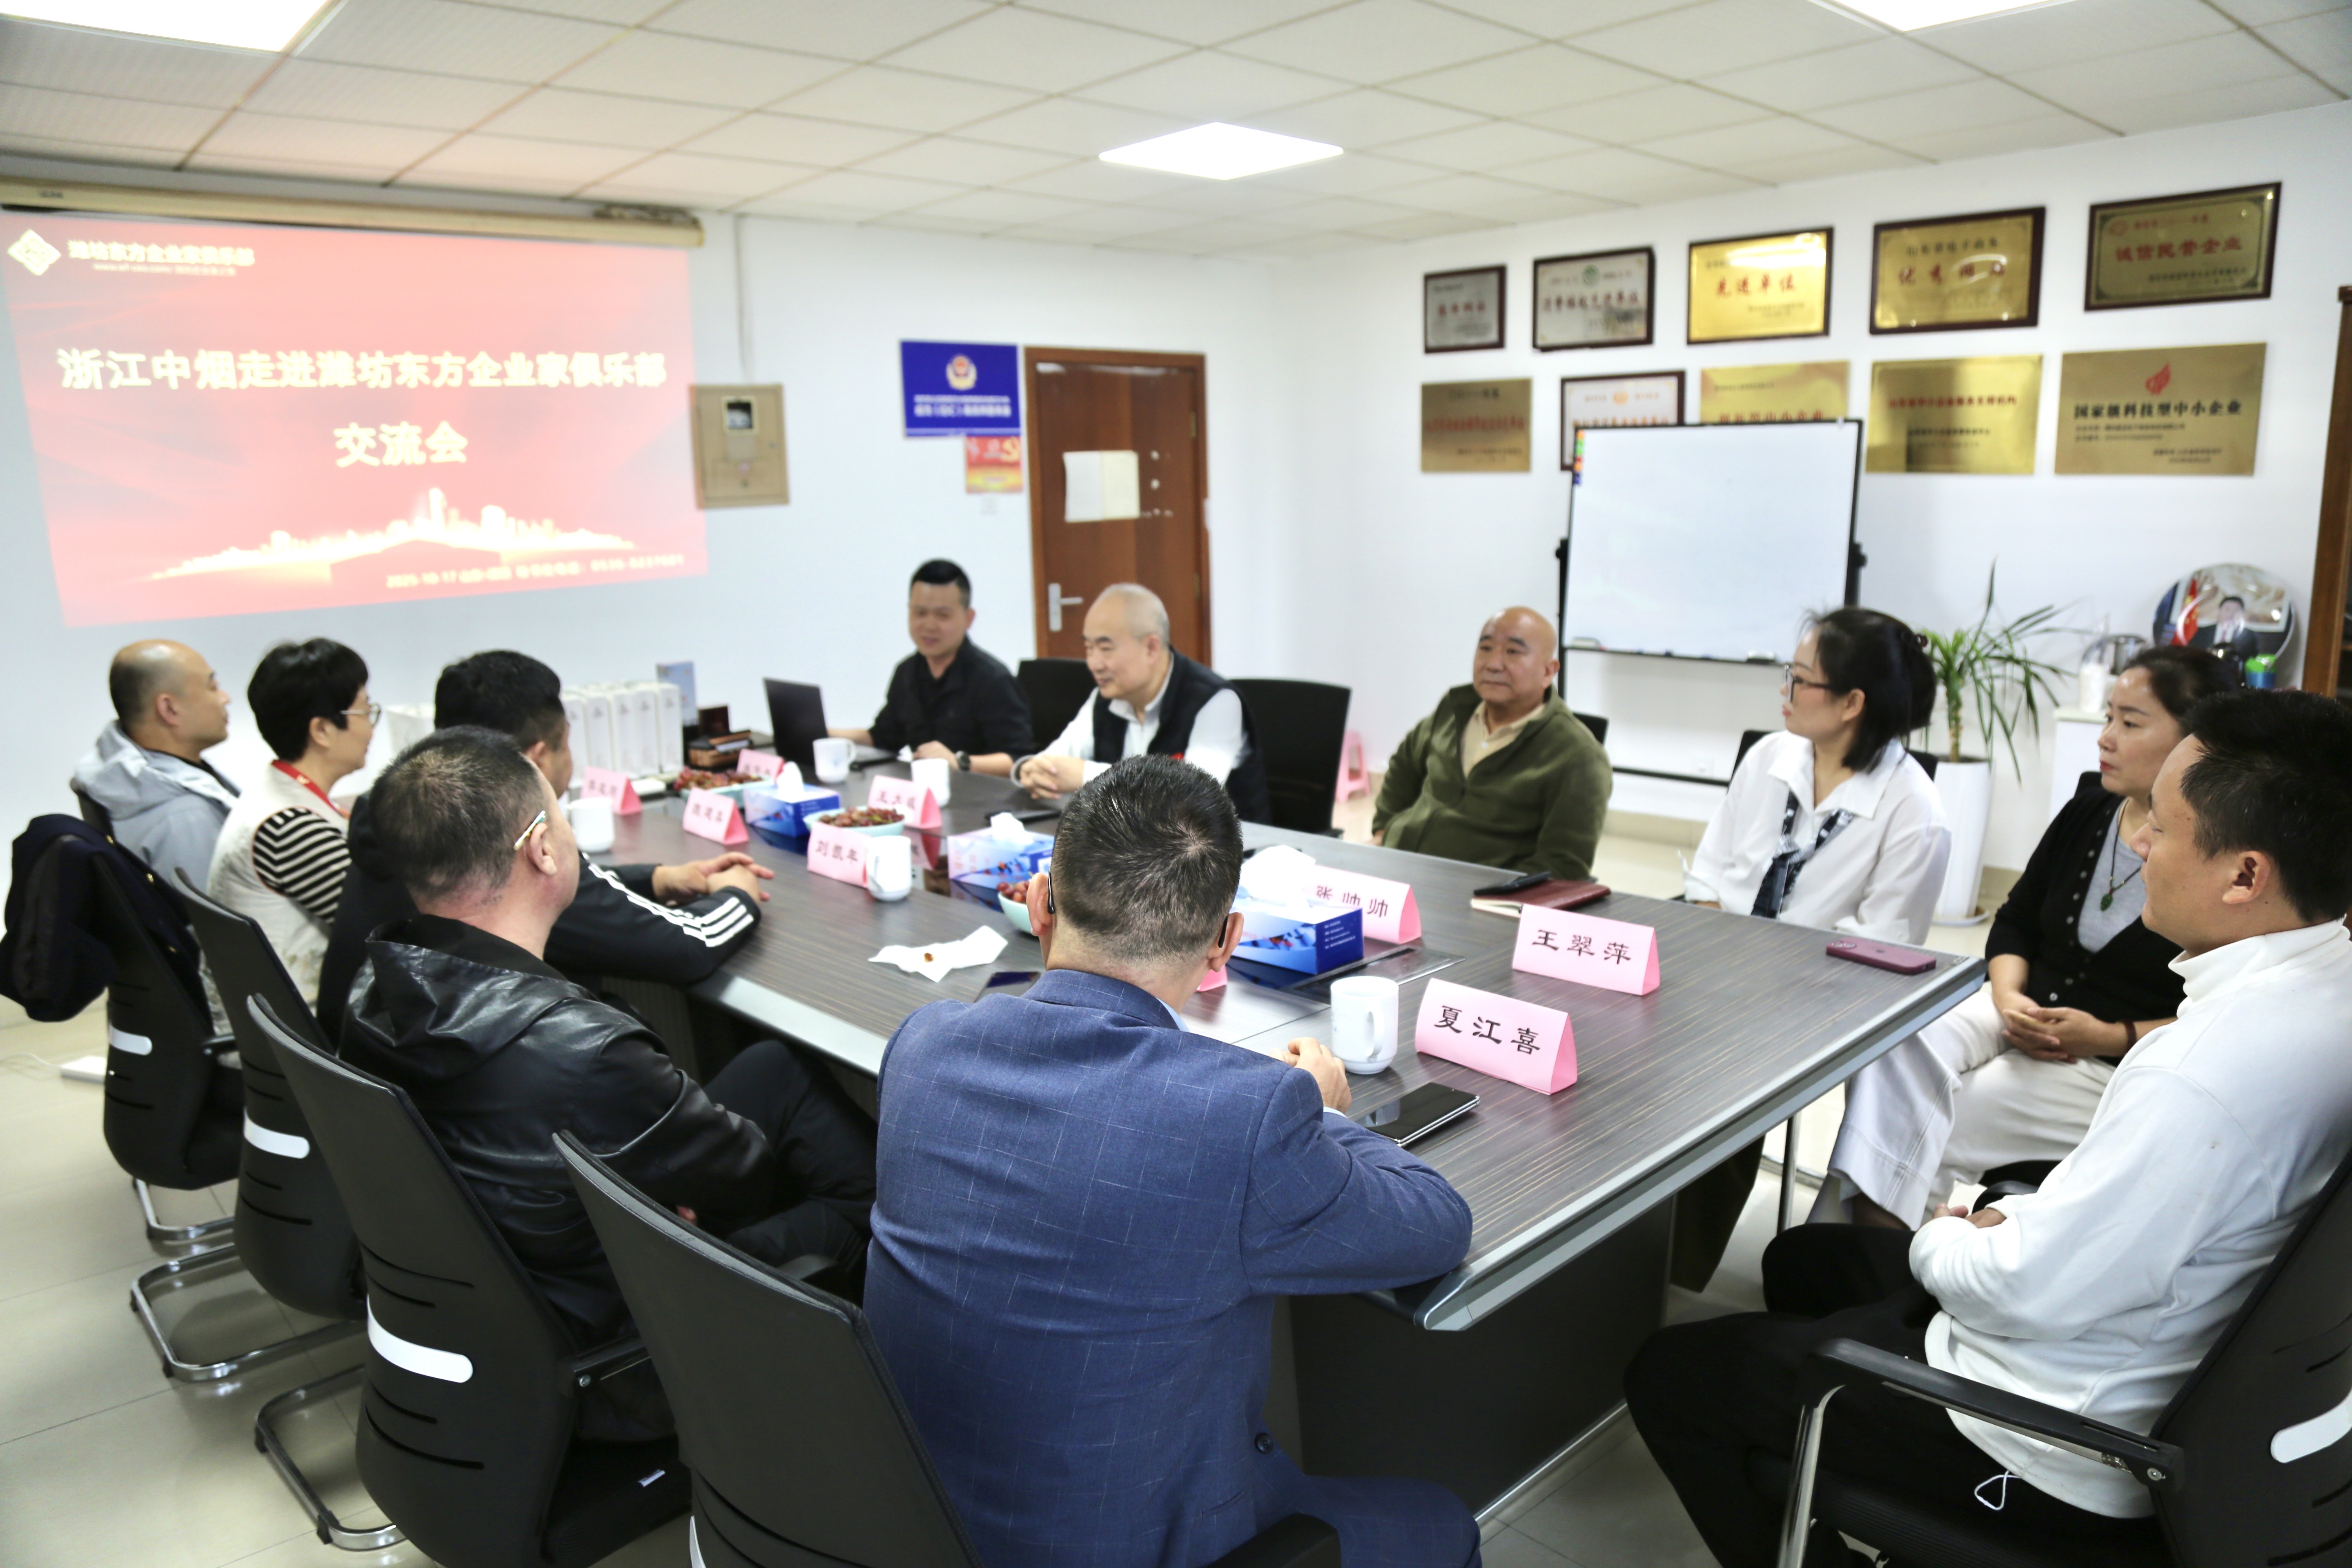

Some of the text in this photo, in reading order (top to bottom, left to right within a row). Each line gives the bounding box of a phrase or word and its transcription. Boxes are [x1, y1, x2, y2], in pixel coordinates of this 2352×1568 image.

[57, 347, 666, 390] 浙江中烟走进潍坊东方企业家俱乐部
[2074, 399, 2241, 419] 国家级科技型中小企业
[333, 420, 468, 467] 交流会
[1316, 885, 1388, 918] 张帅帅
[1531, 929, 1632, 965] 王翠萍
[1433, 1004, 1541, 1055] 夏江喜
